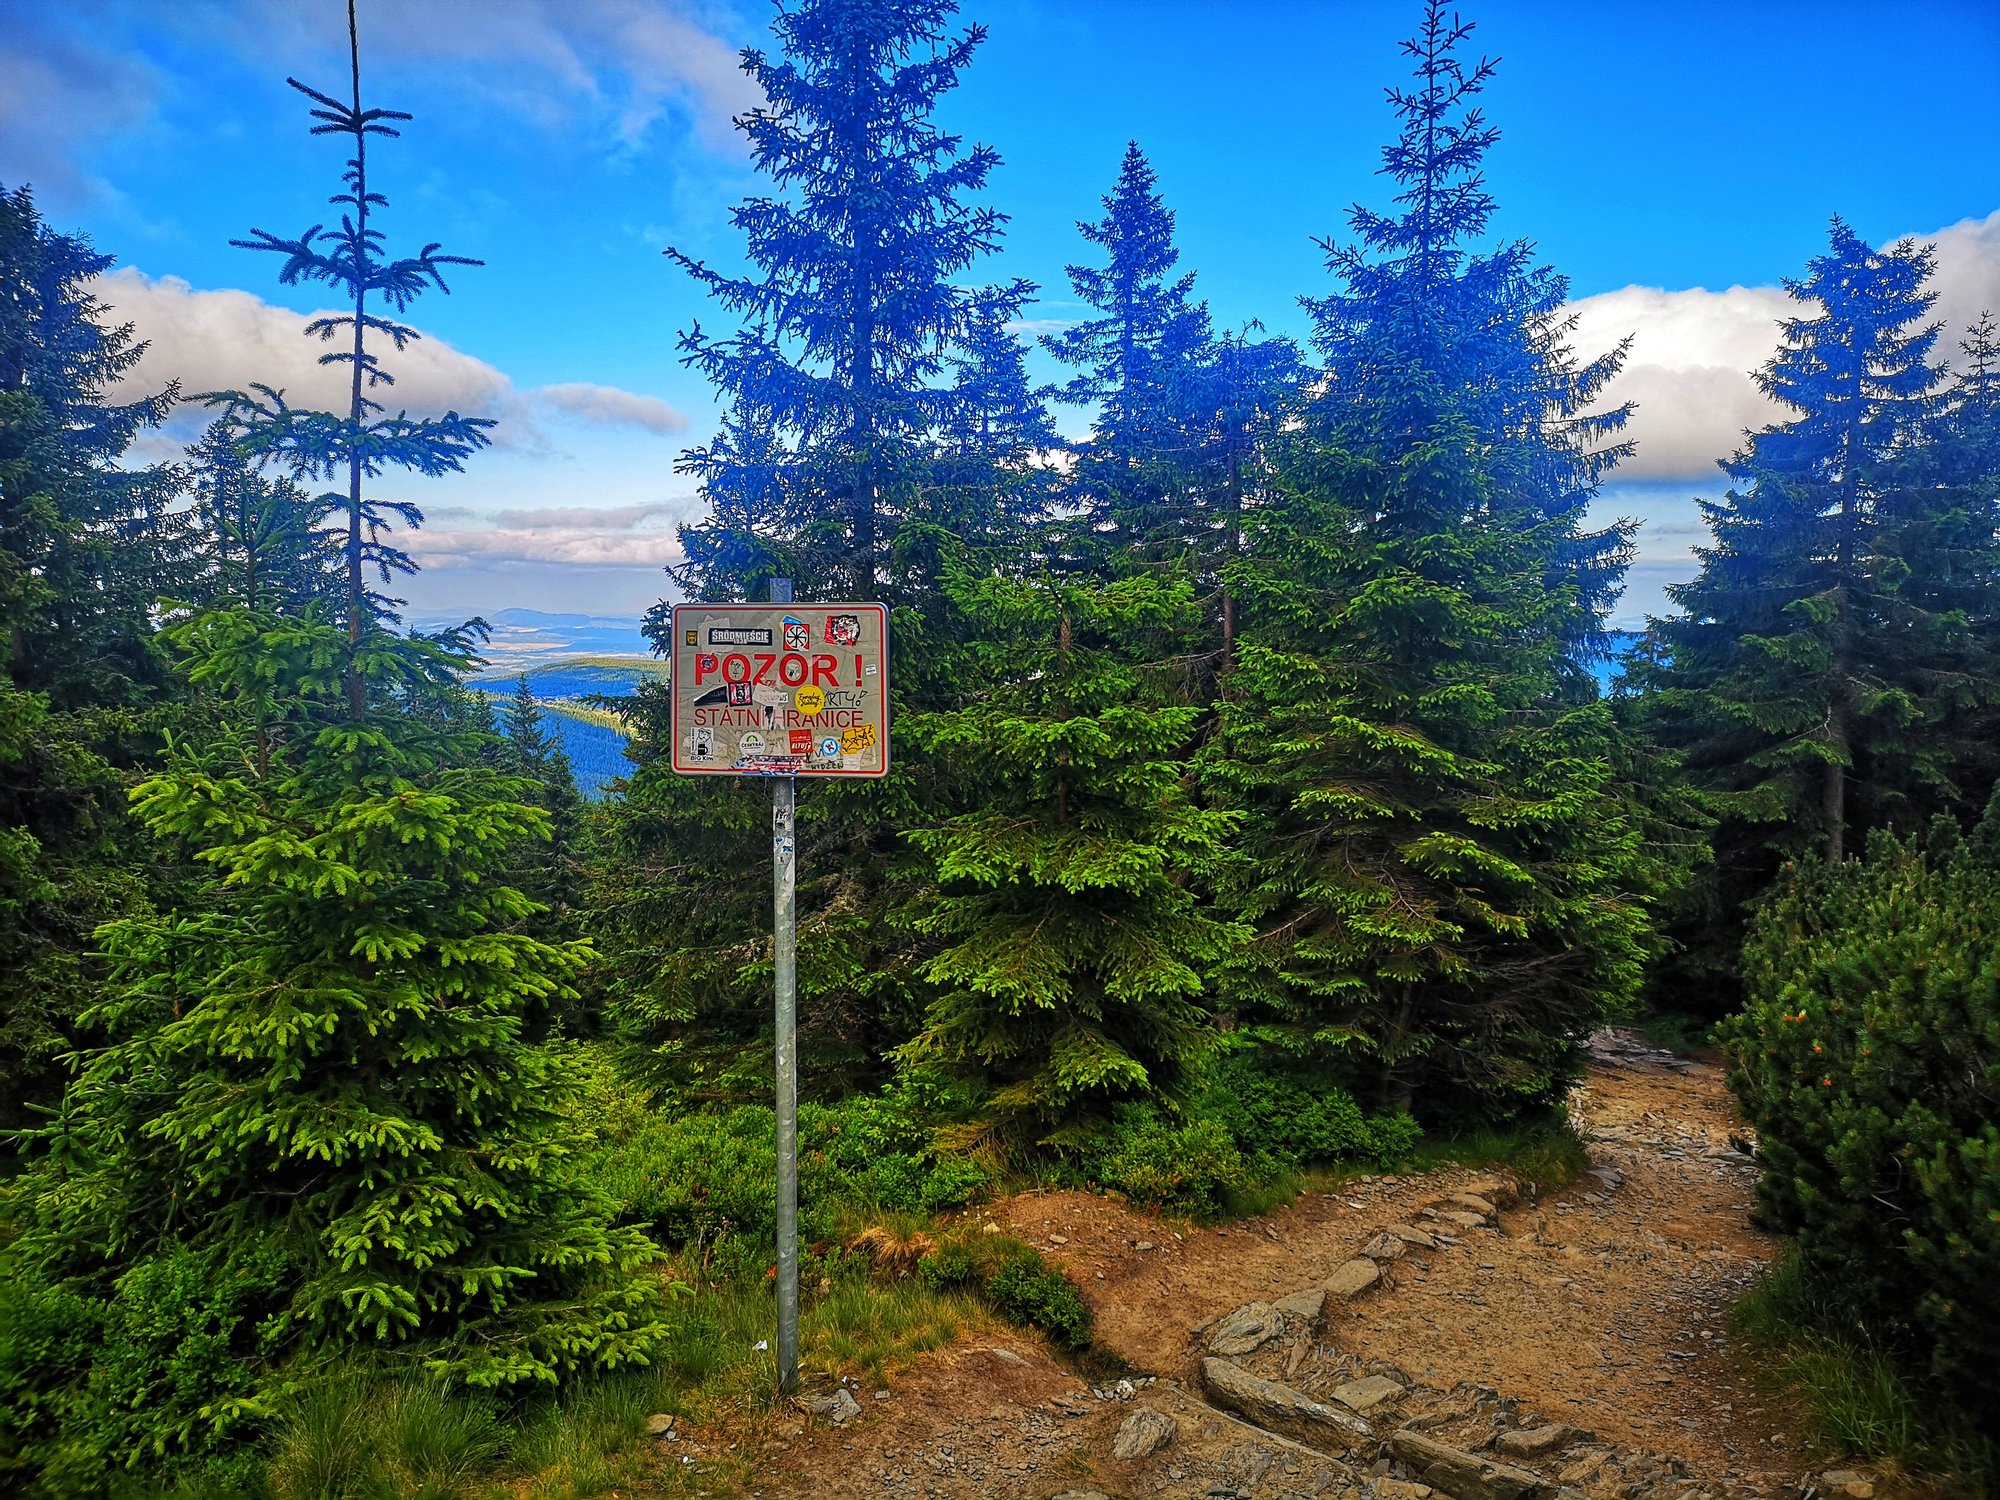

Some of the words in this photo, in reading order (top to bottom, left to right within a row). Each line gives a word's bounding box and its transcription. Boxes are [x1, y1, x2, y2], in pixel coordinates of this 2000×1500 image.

[711, 629, 769, 641] ŚRÓDMIEŚCIE
[695, 653, 840, 687] POZOR
[855, 654, 863, 687] !
[773, 710, 864, 728] HRANICE
